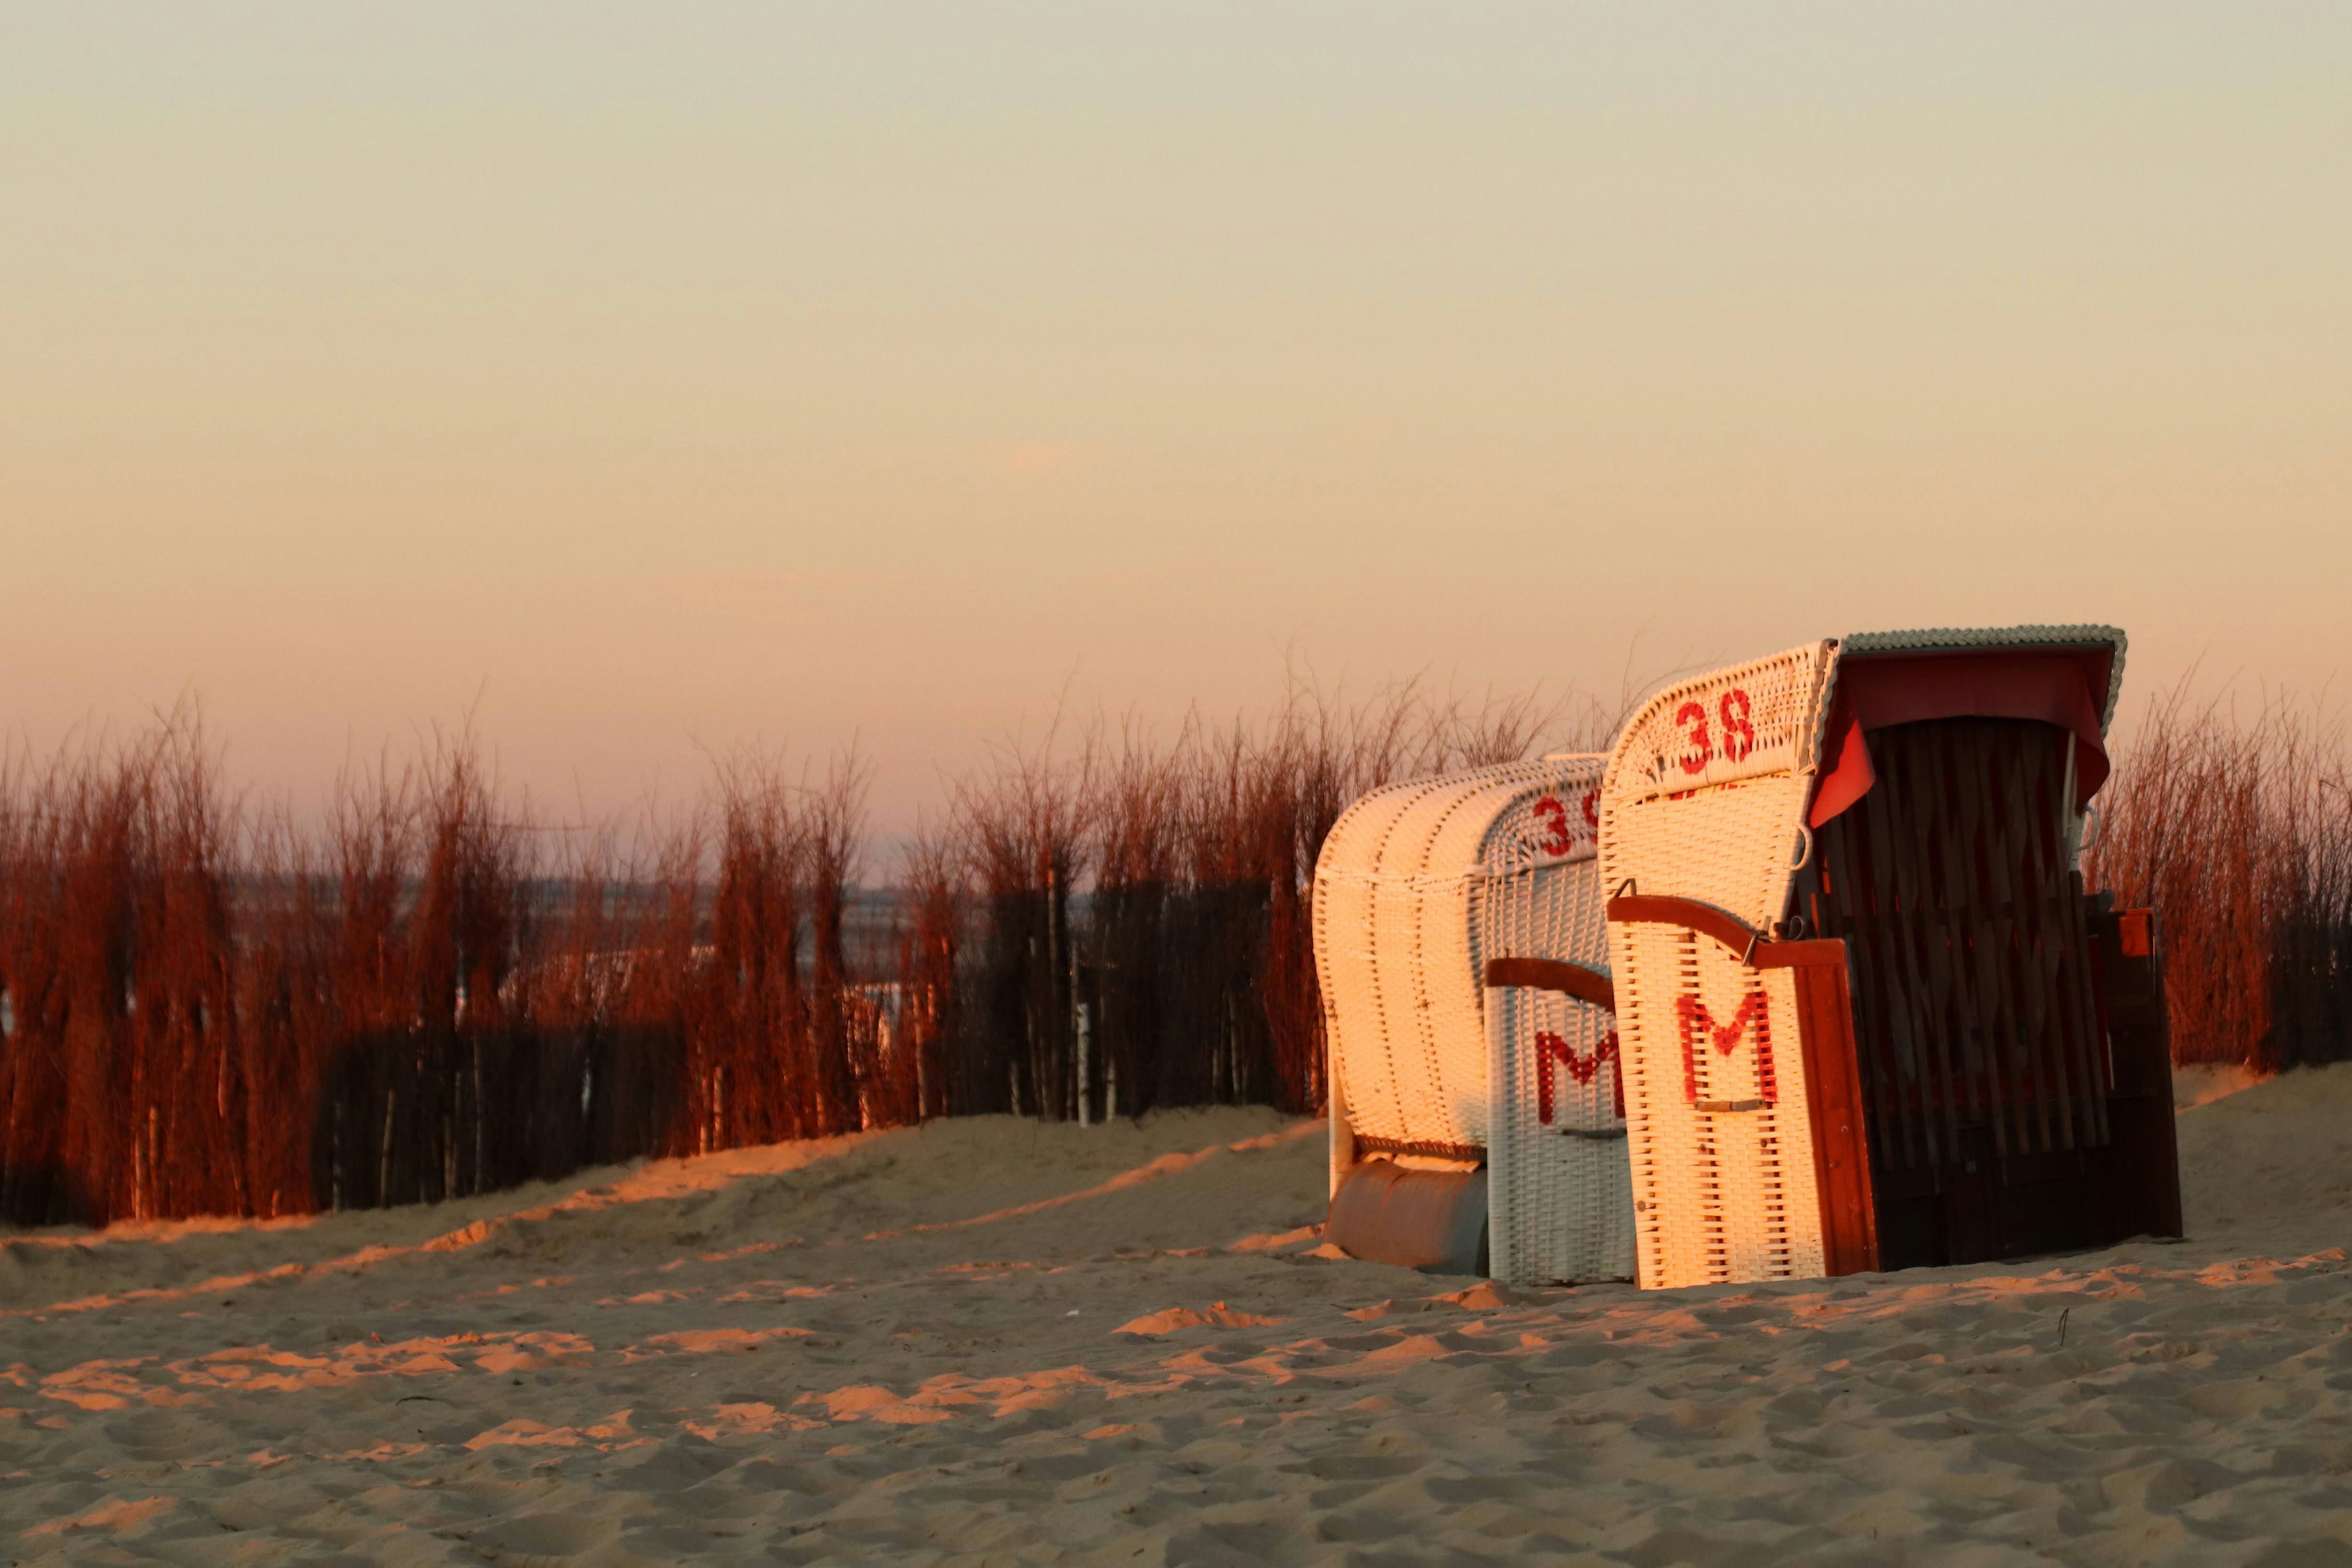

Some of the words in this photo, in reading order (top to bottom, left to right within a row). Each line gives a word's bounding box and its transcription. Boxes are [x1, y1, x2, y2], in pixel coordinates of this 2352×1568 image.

[1676, 689, 1755, 775] 38
[1535, 1030, 1626, 1125] M
[1676, 990, 1778, 1102] M
